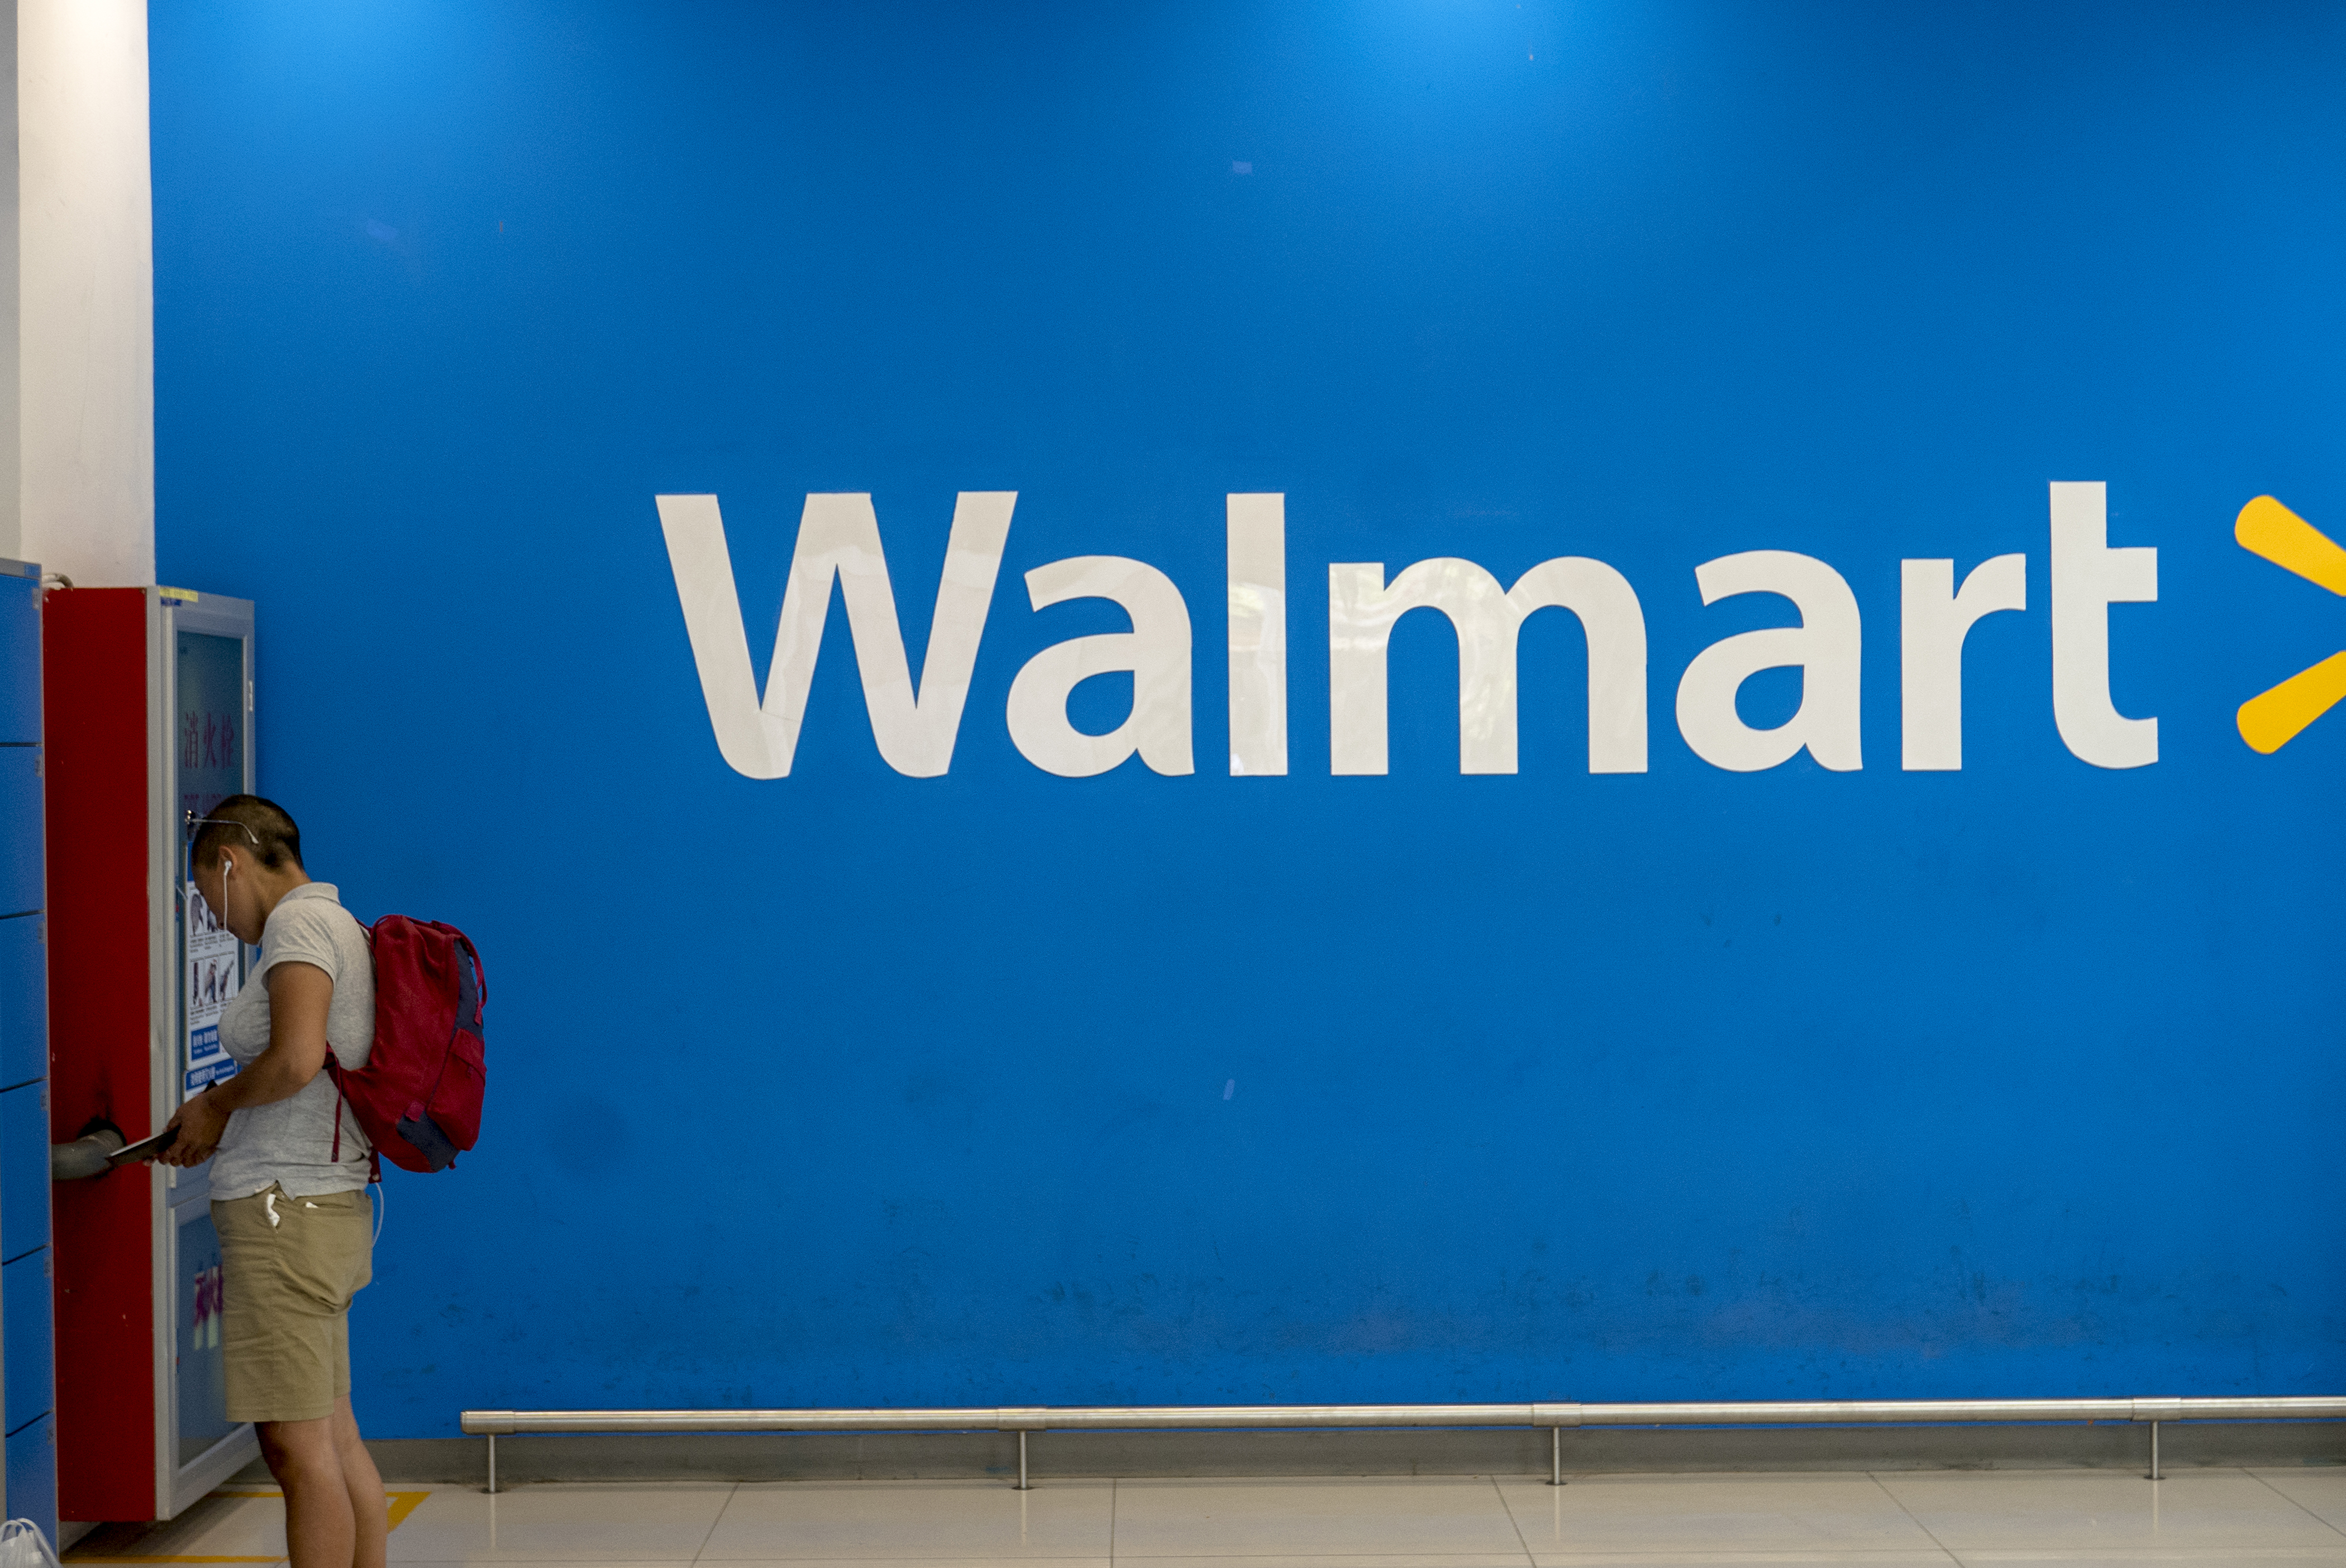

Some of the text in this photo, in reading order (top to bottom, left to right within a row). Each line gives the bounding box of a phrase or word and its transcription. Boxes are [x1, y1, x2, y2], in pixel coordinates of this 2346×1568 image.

[655, 481, 2158, 780] Walmart
[184, 710, 235, 769] 消火栓
